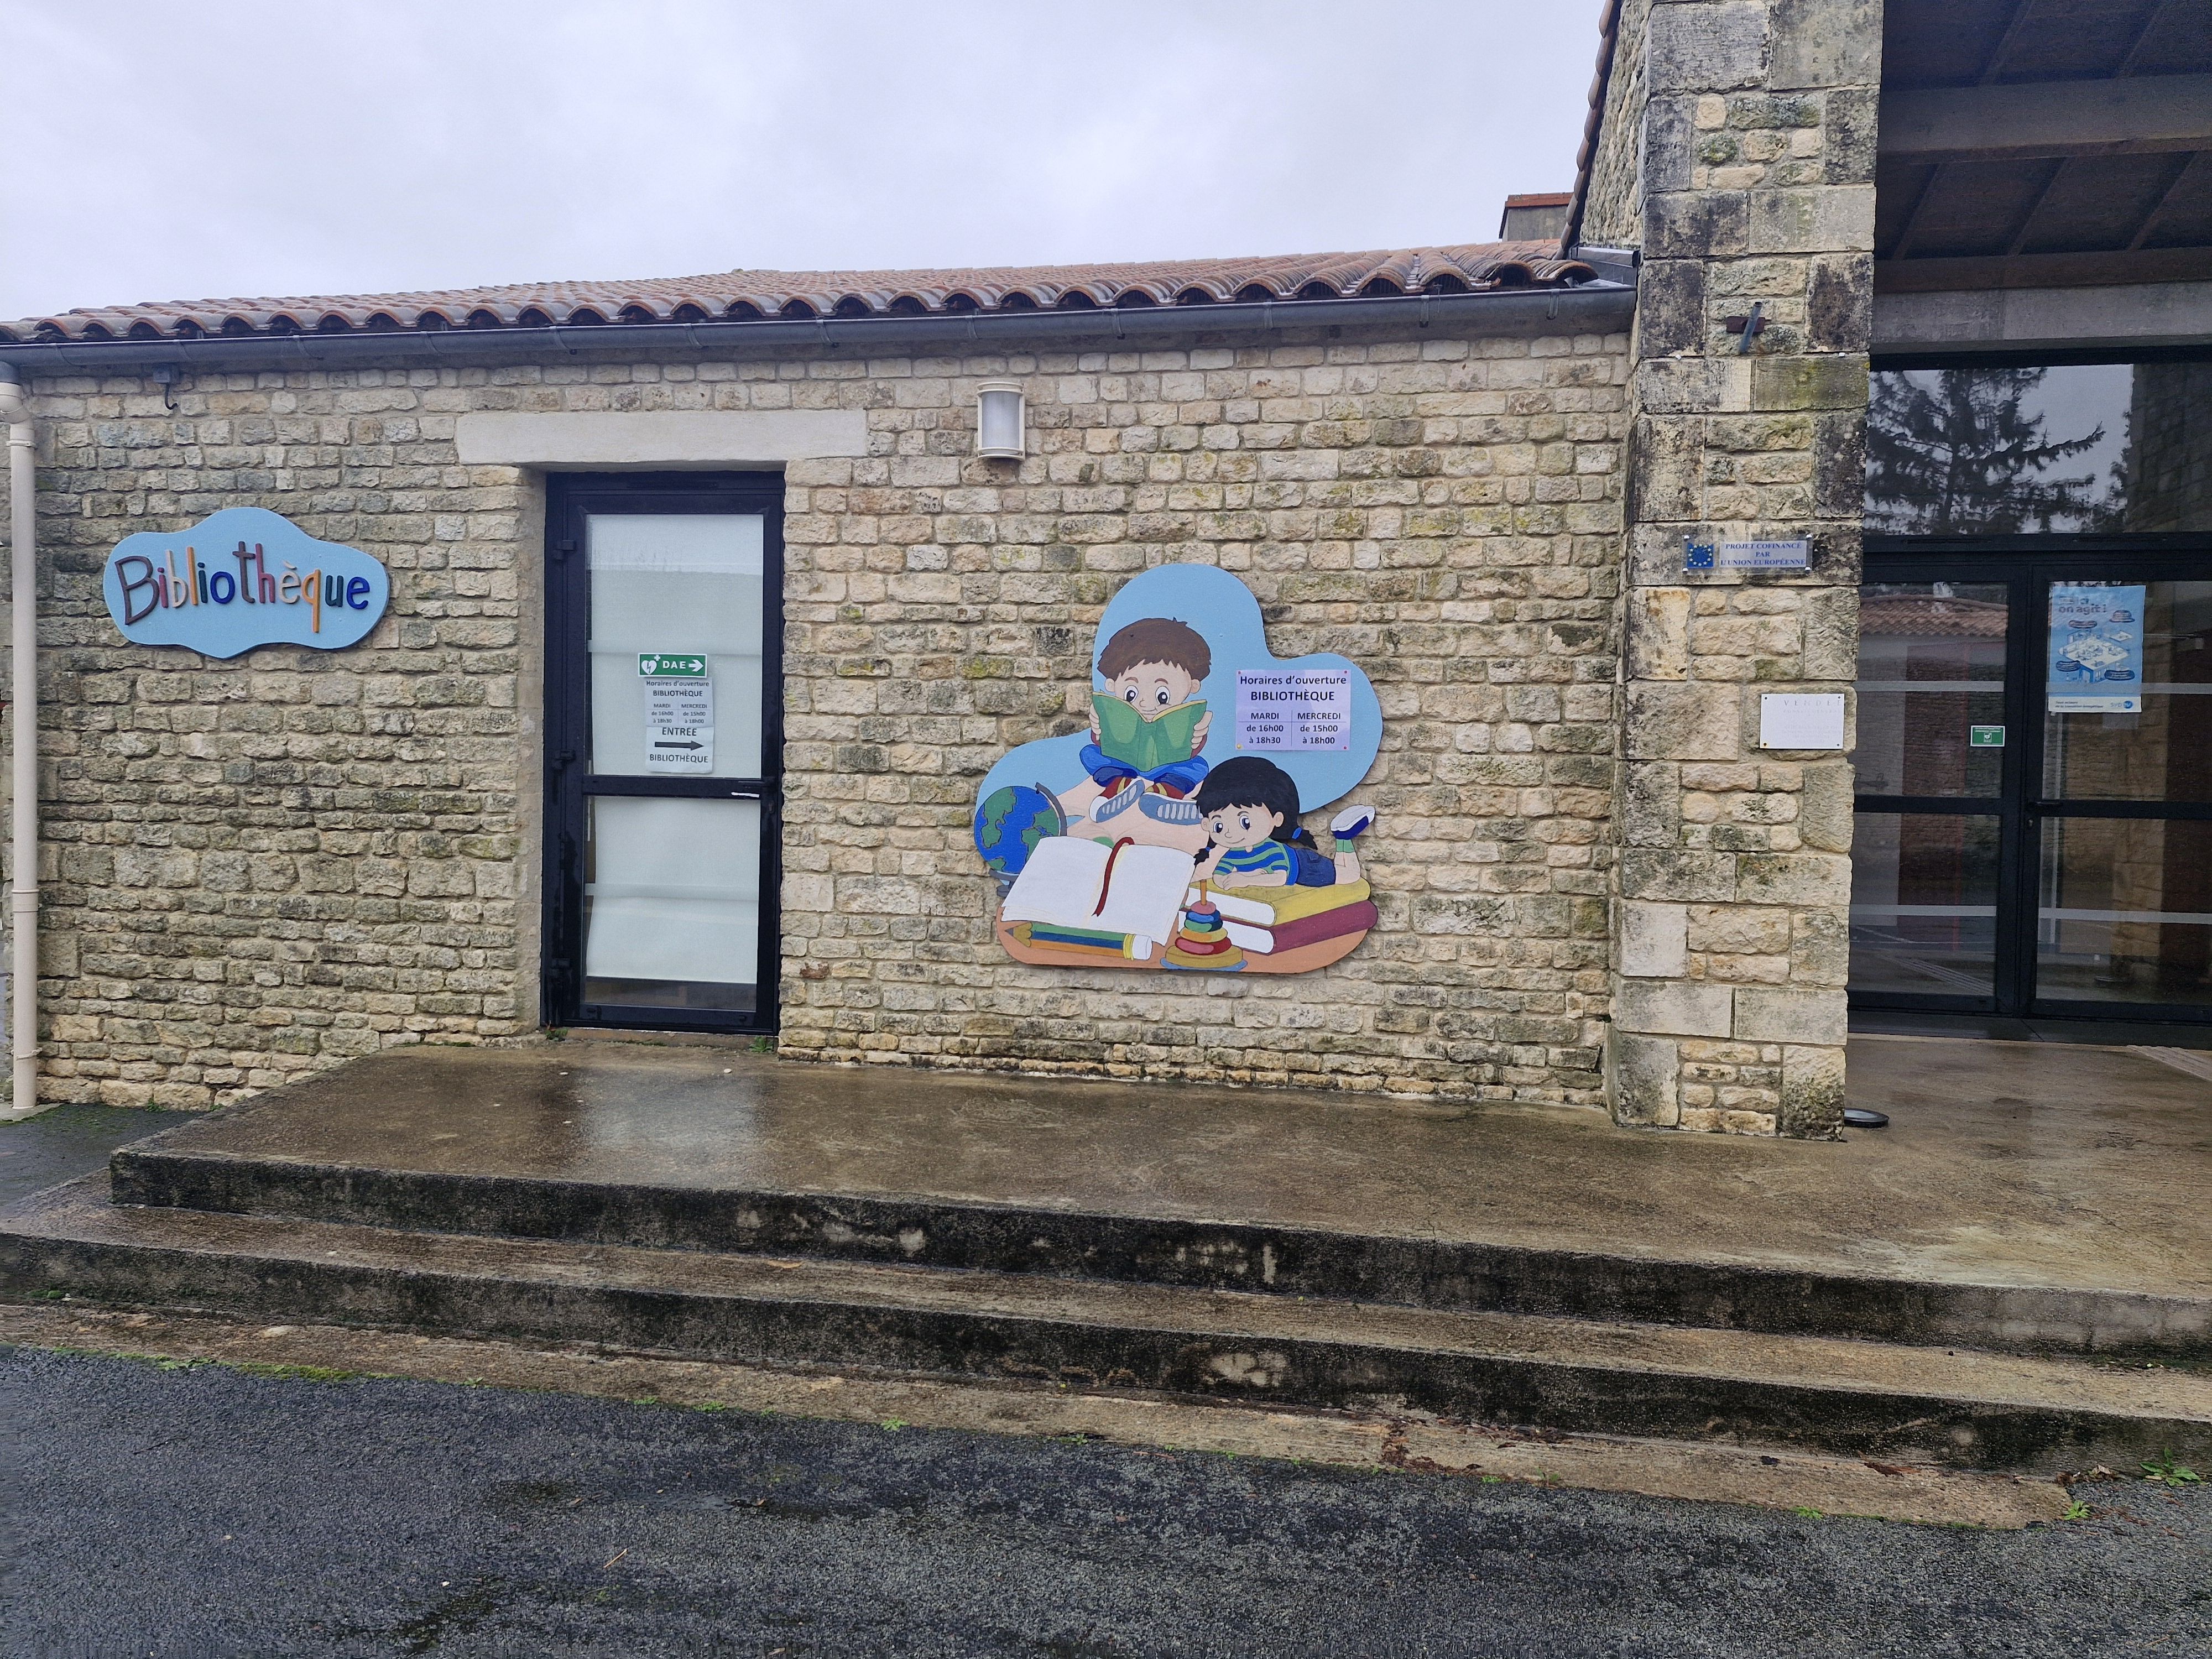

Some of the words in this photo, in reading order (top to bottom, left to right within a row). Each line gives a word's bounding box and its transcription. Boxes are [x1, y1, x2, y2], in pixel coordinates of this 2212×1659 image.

[114, 540, 370, 633] Bibliothèque
[662, 660, 686, 669] DAE
[1240, 676, 1282, 685] Horaires
[1286, 675, 1347, 685] d'ouverture
[653, 688, 703, 697] BIBLIOTHÈQUE
[1251, 689, 1334, 702] BIBLIOTHÈQUE
[650, 753, 708, 763] BIBLIOTHÈQUE
